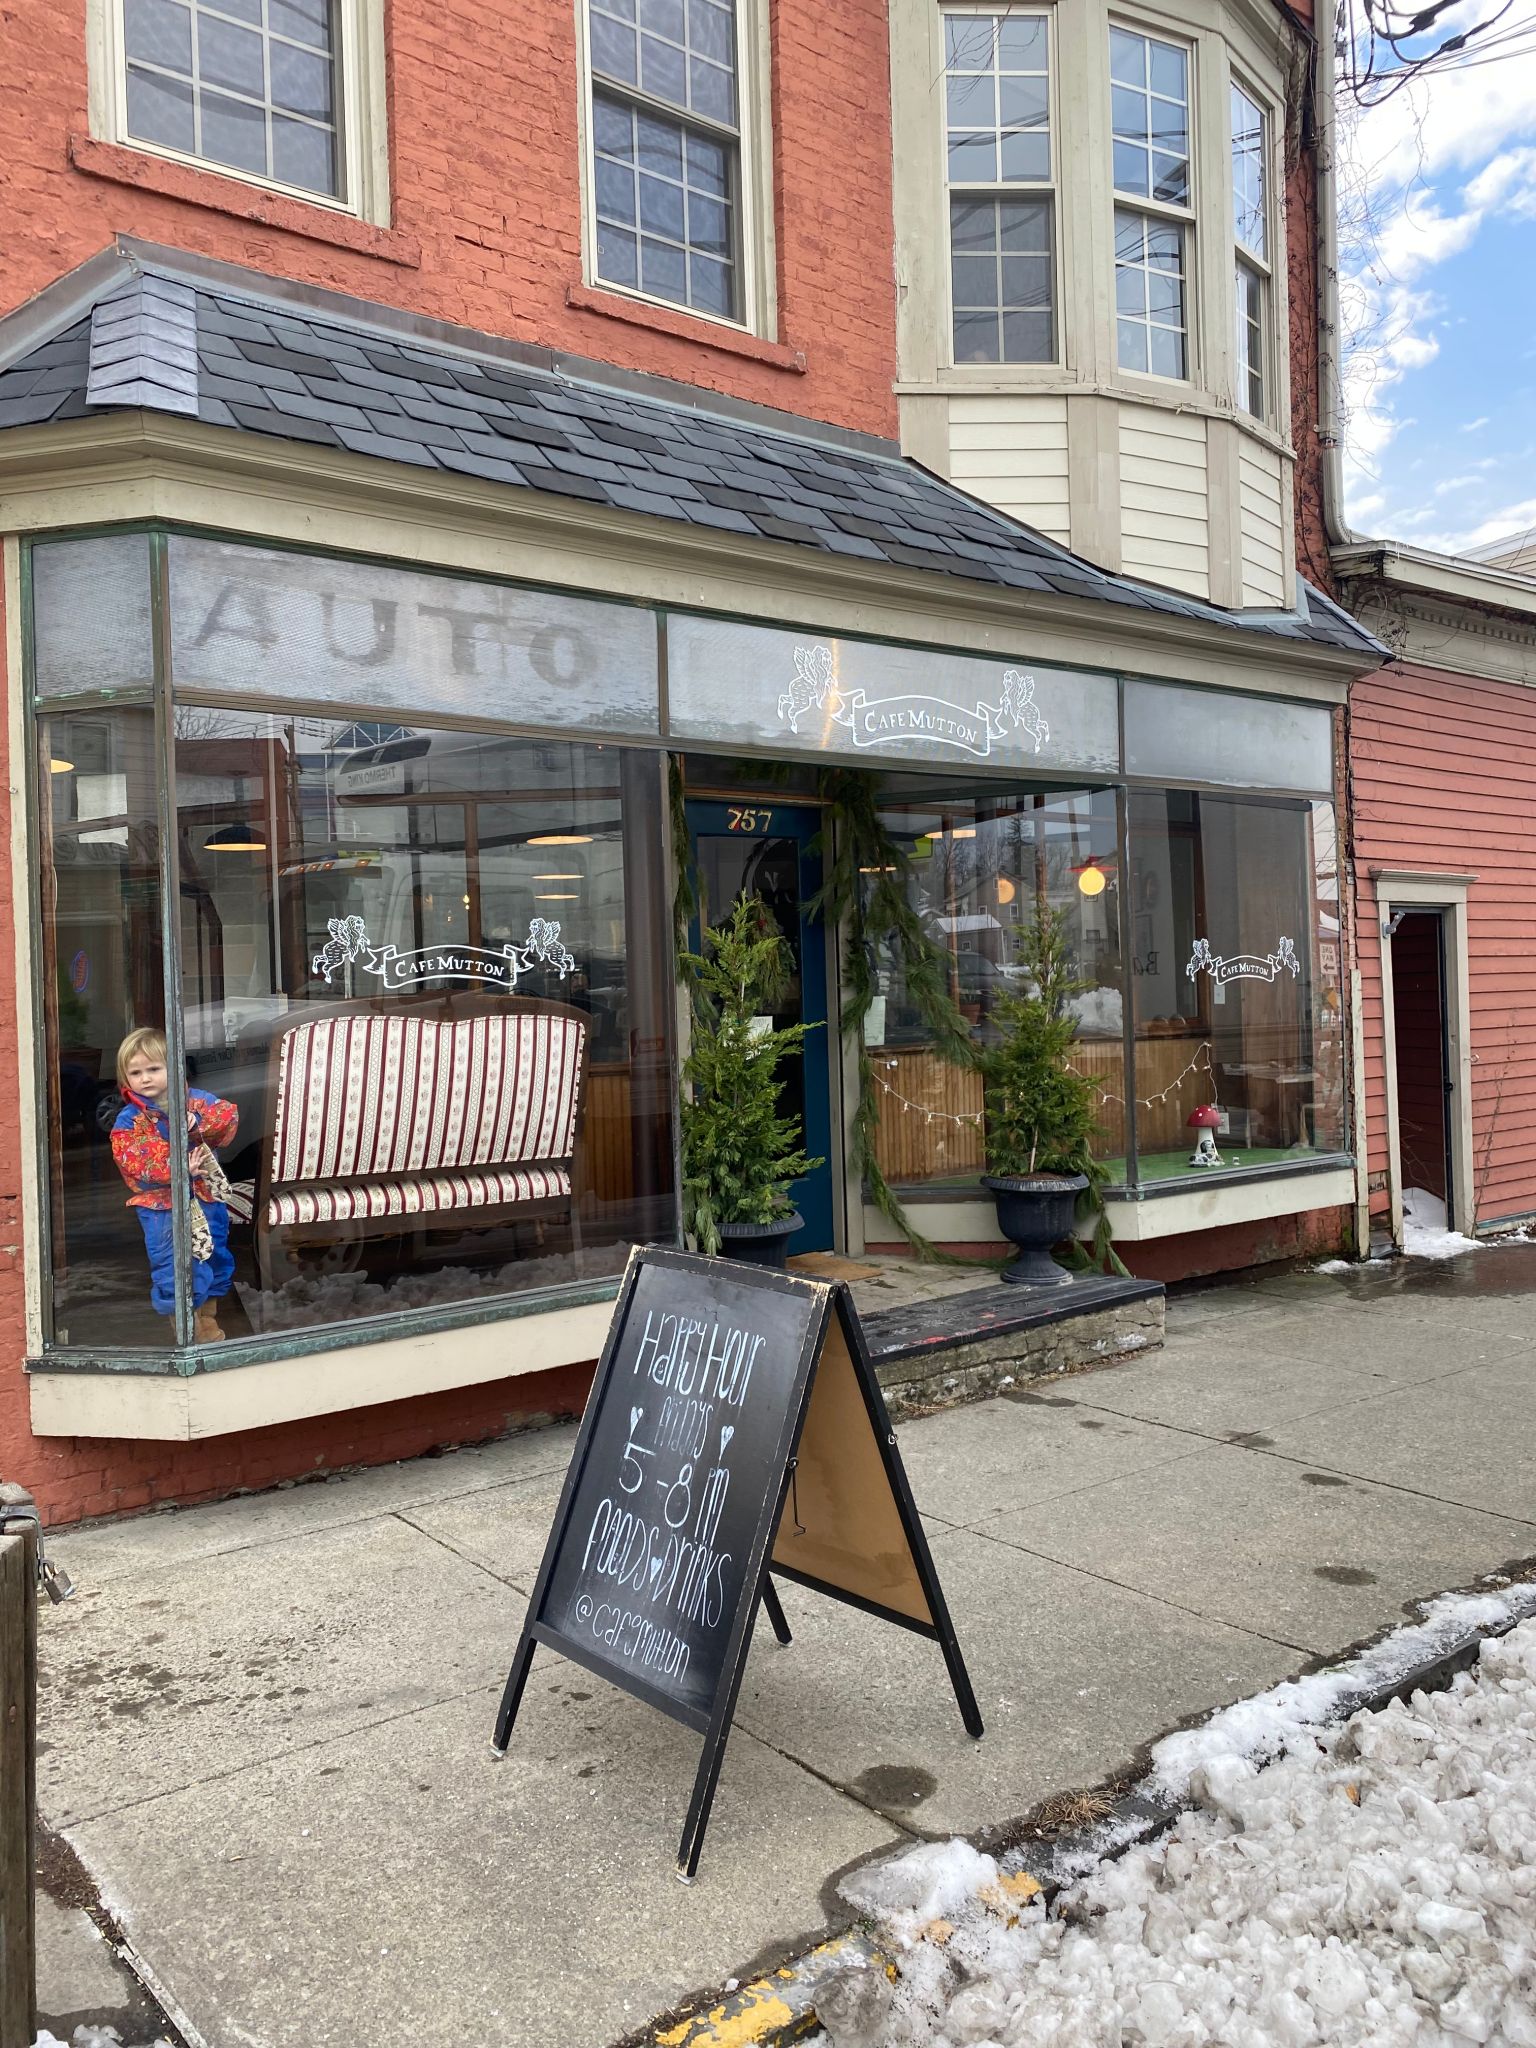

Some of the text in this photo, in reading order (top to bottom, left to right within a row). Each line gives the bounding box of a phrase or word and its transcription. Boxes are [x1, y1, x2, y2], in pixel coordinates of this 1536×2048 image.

[194, 578, 598, 690] AUTO
[863, 709, 976, 743] CAFE MUTTON
[726, 806, 773, 833] 757
[395, 955, 505, 978] CAFE MUTTON
[1220, 962, 1269, 978] CAFE MUTTON
